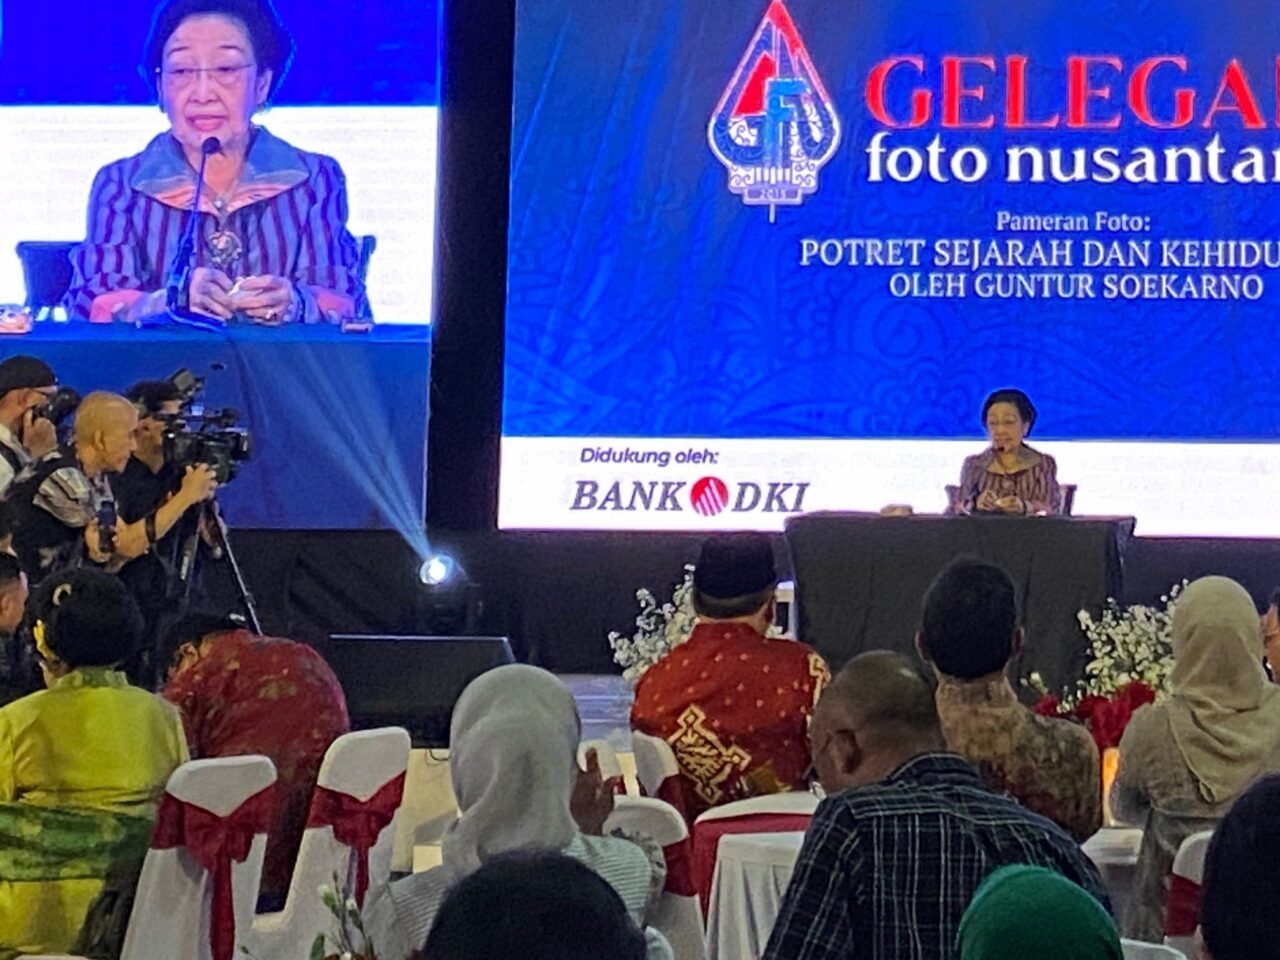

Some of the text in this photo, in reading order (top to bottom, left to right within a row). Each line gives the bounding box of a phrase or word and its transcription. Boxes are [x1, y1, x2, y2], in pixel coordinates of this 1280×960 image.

[866, 131, 987, 183] foto
[996, 211, 1151, 232] Pameran Foto:
[800, 240, 926, 267] POTRET
[934, 240, 1072, 270] SEJARAH
[1083, 240, 1151, 268] DAN
[889, 274, 1264, 300] OLEH GUNTUR SOEKARNO
[580, 447, 719, 467] Didukung oleh:
[570, 480, 811, 512] BANK DKI
